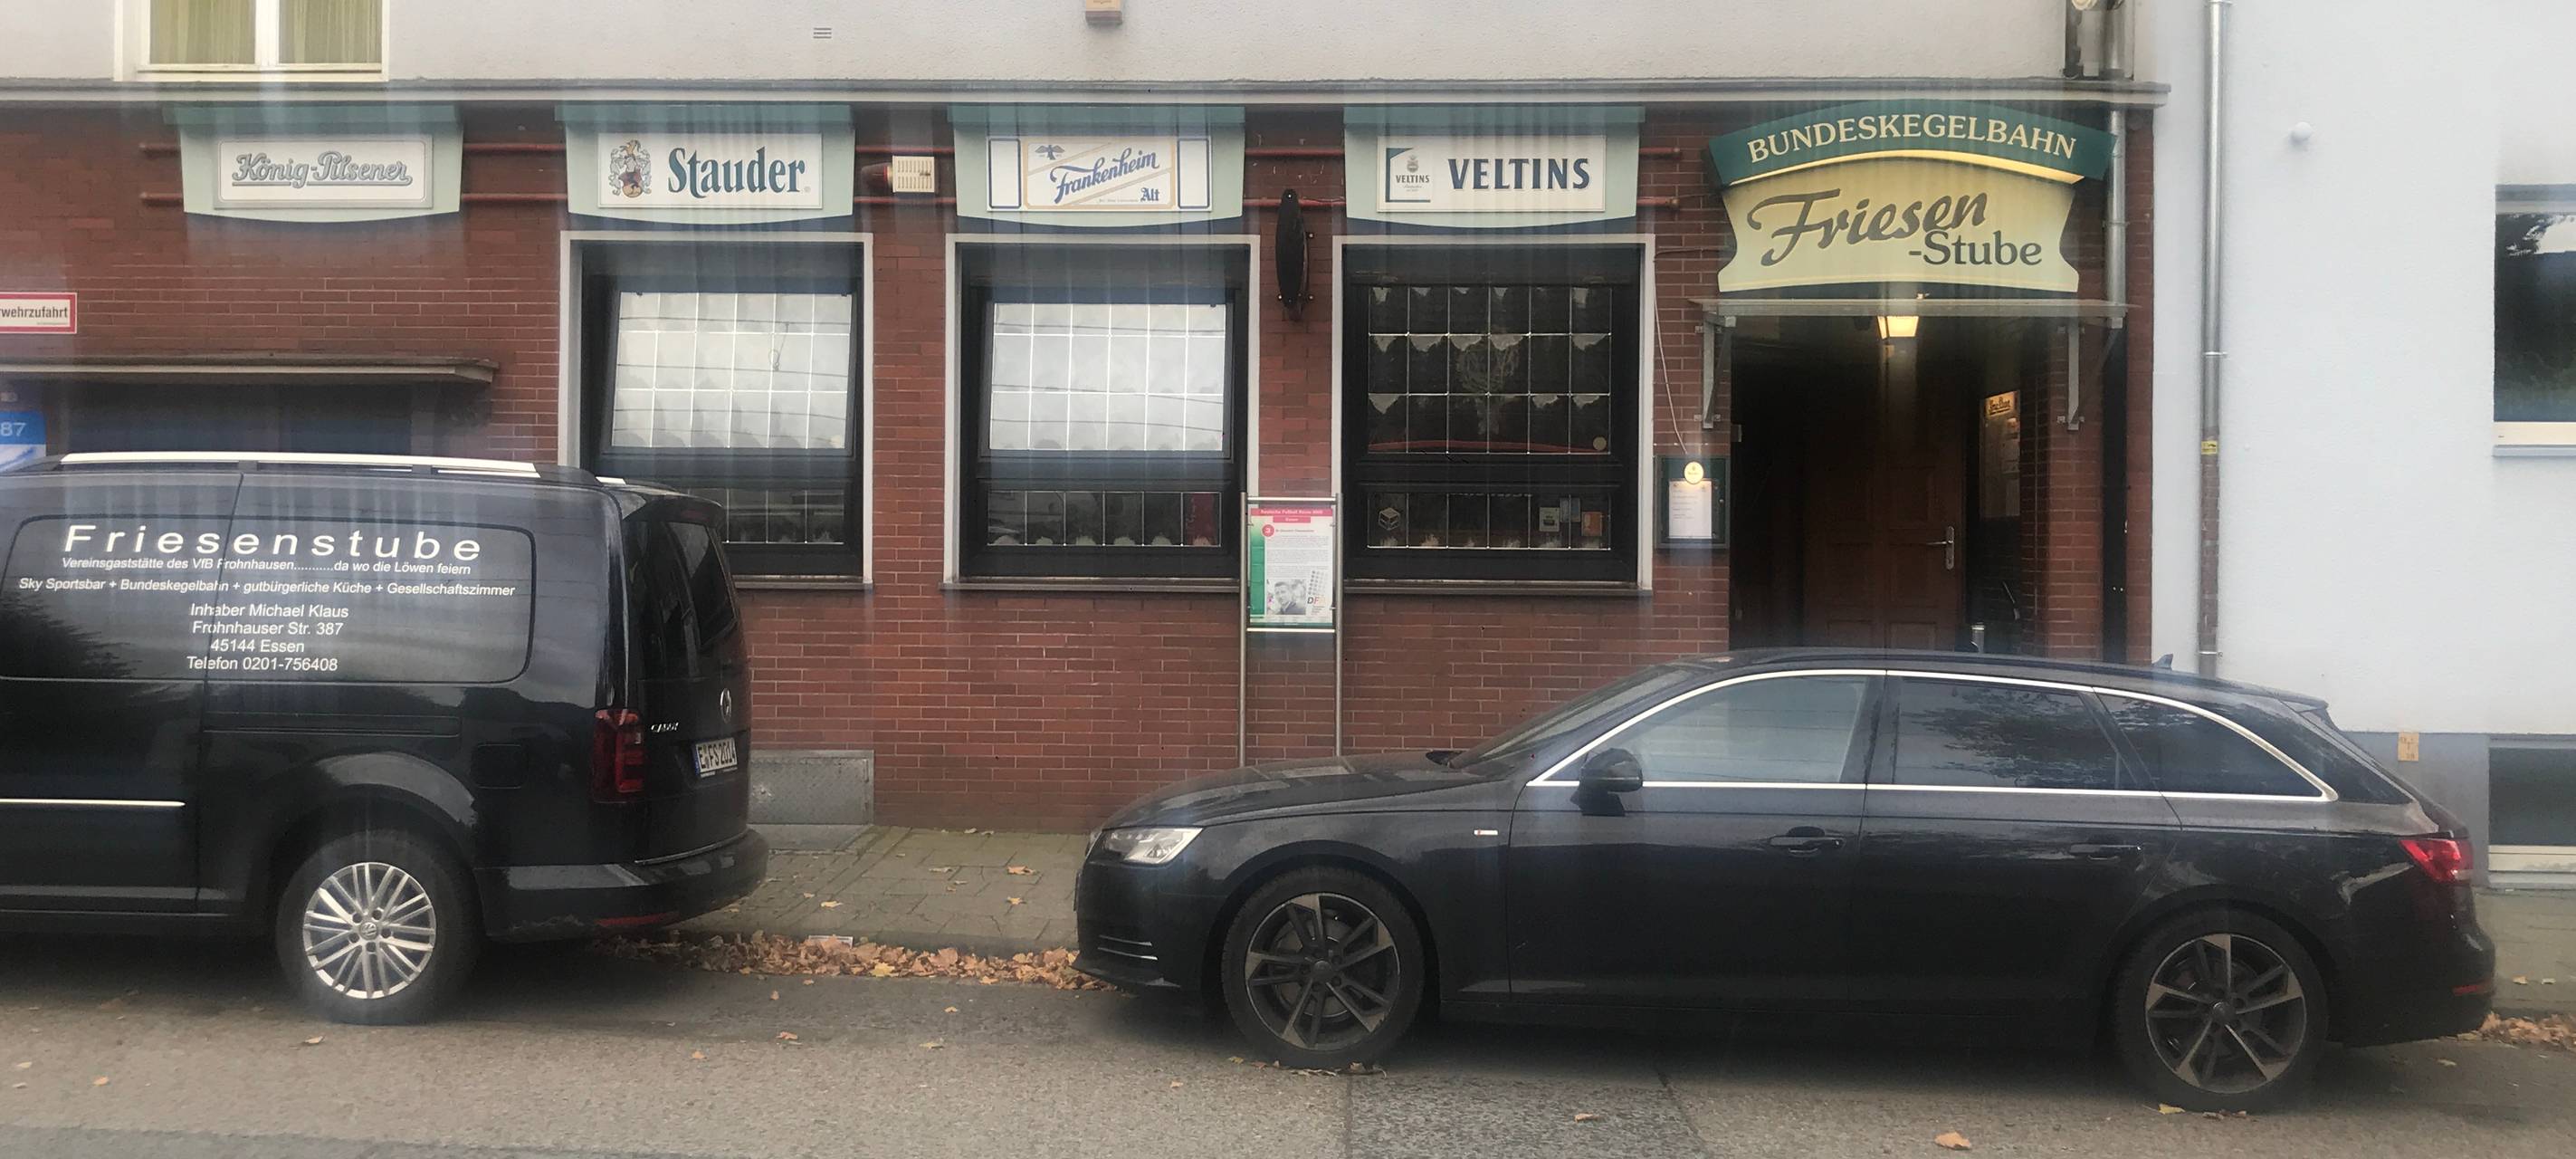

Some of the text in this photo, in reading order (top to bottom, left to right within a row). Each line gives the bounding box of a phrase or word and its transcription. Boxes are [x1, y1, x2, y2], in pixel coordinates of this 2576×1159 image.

[1747, 113, 2076, 164] BUNDESKEGELBAHN
[232, 150, 413, 188] König-Pilsener
[668, 146, 806, 198] Stauder
[1049, 147, 1160, 205] Frankenheim
[1448, 158, 1590, 189] VELTINS
[1395, 175, 1430, 184] VELTINS
[1140, 187, 1160, 202] Alt
[1746, 188, 1988, 266] Friesen
[64, 525, 481, 560] Friesenstube
[62, 557, 163, 570] Vereinsgaststätte
[167, 558, 188, 569] des
[192, 558, 214, 569] VfB
[352, 562, 369, 571] wo
[373, 561, 391, 572] die
[394, 562, 434, 573] Löwen
[436, 563, 471, 574] feiern
[19, 578, 43, 591] Sky
[46, 578, 106, 592] Sportsbar
[120, 580, 229, 593] Bundeskegelbahn
[243, 580, 329, 595] gutbürgerliche
[333, 581, 372, 593] Küche
[387, 582, 515, 596] Gesellschaftszimmer
[190, 603, 349, 618] Inhaber Michael Klaus
[192, 621, 344, 635] Frohnhauser Str. 387
[210, 639, 305, 652] 45144 Essen
[187, 656, 338, 671] Telefon 0201-756408
